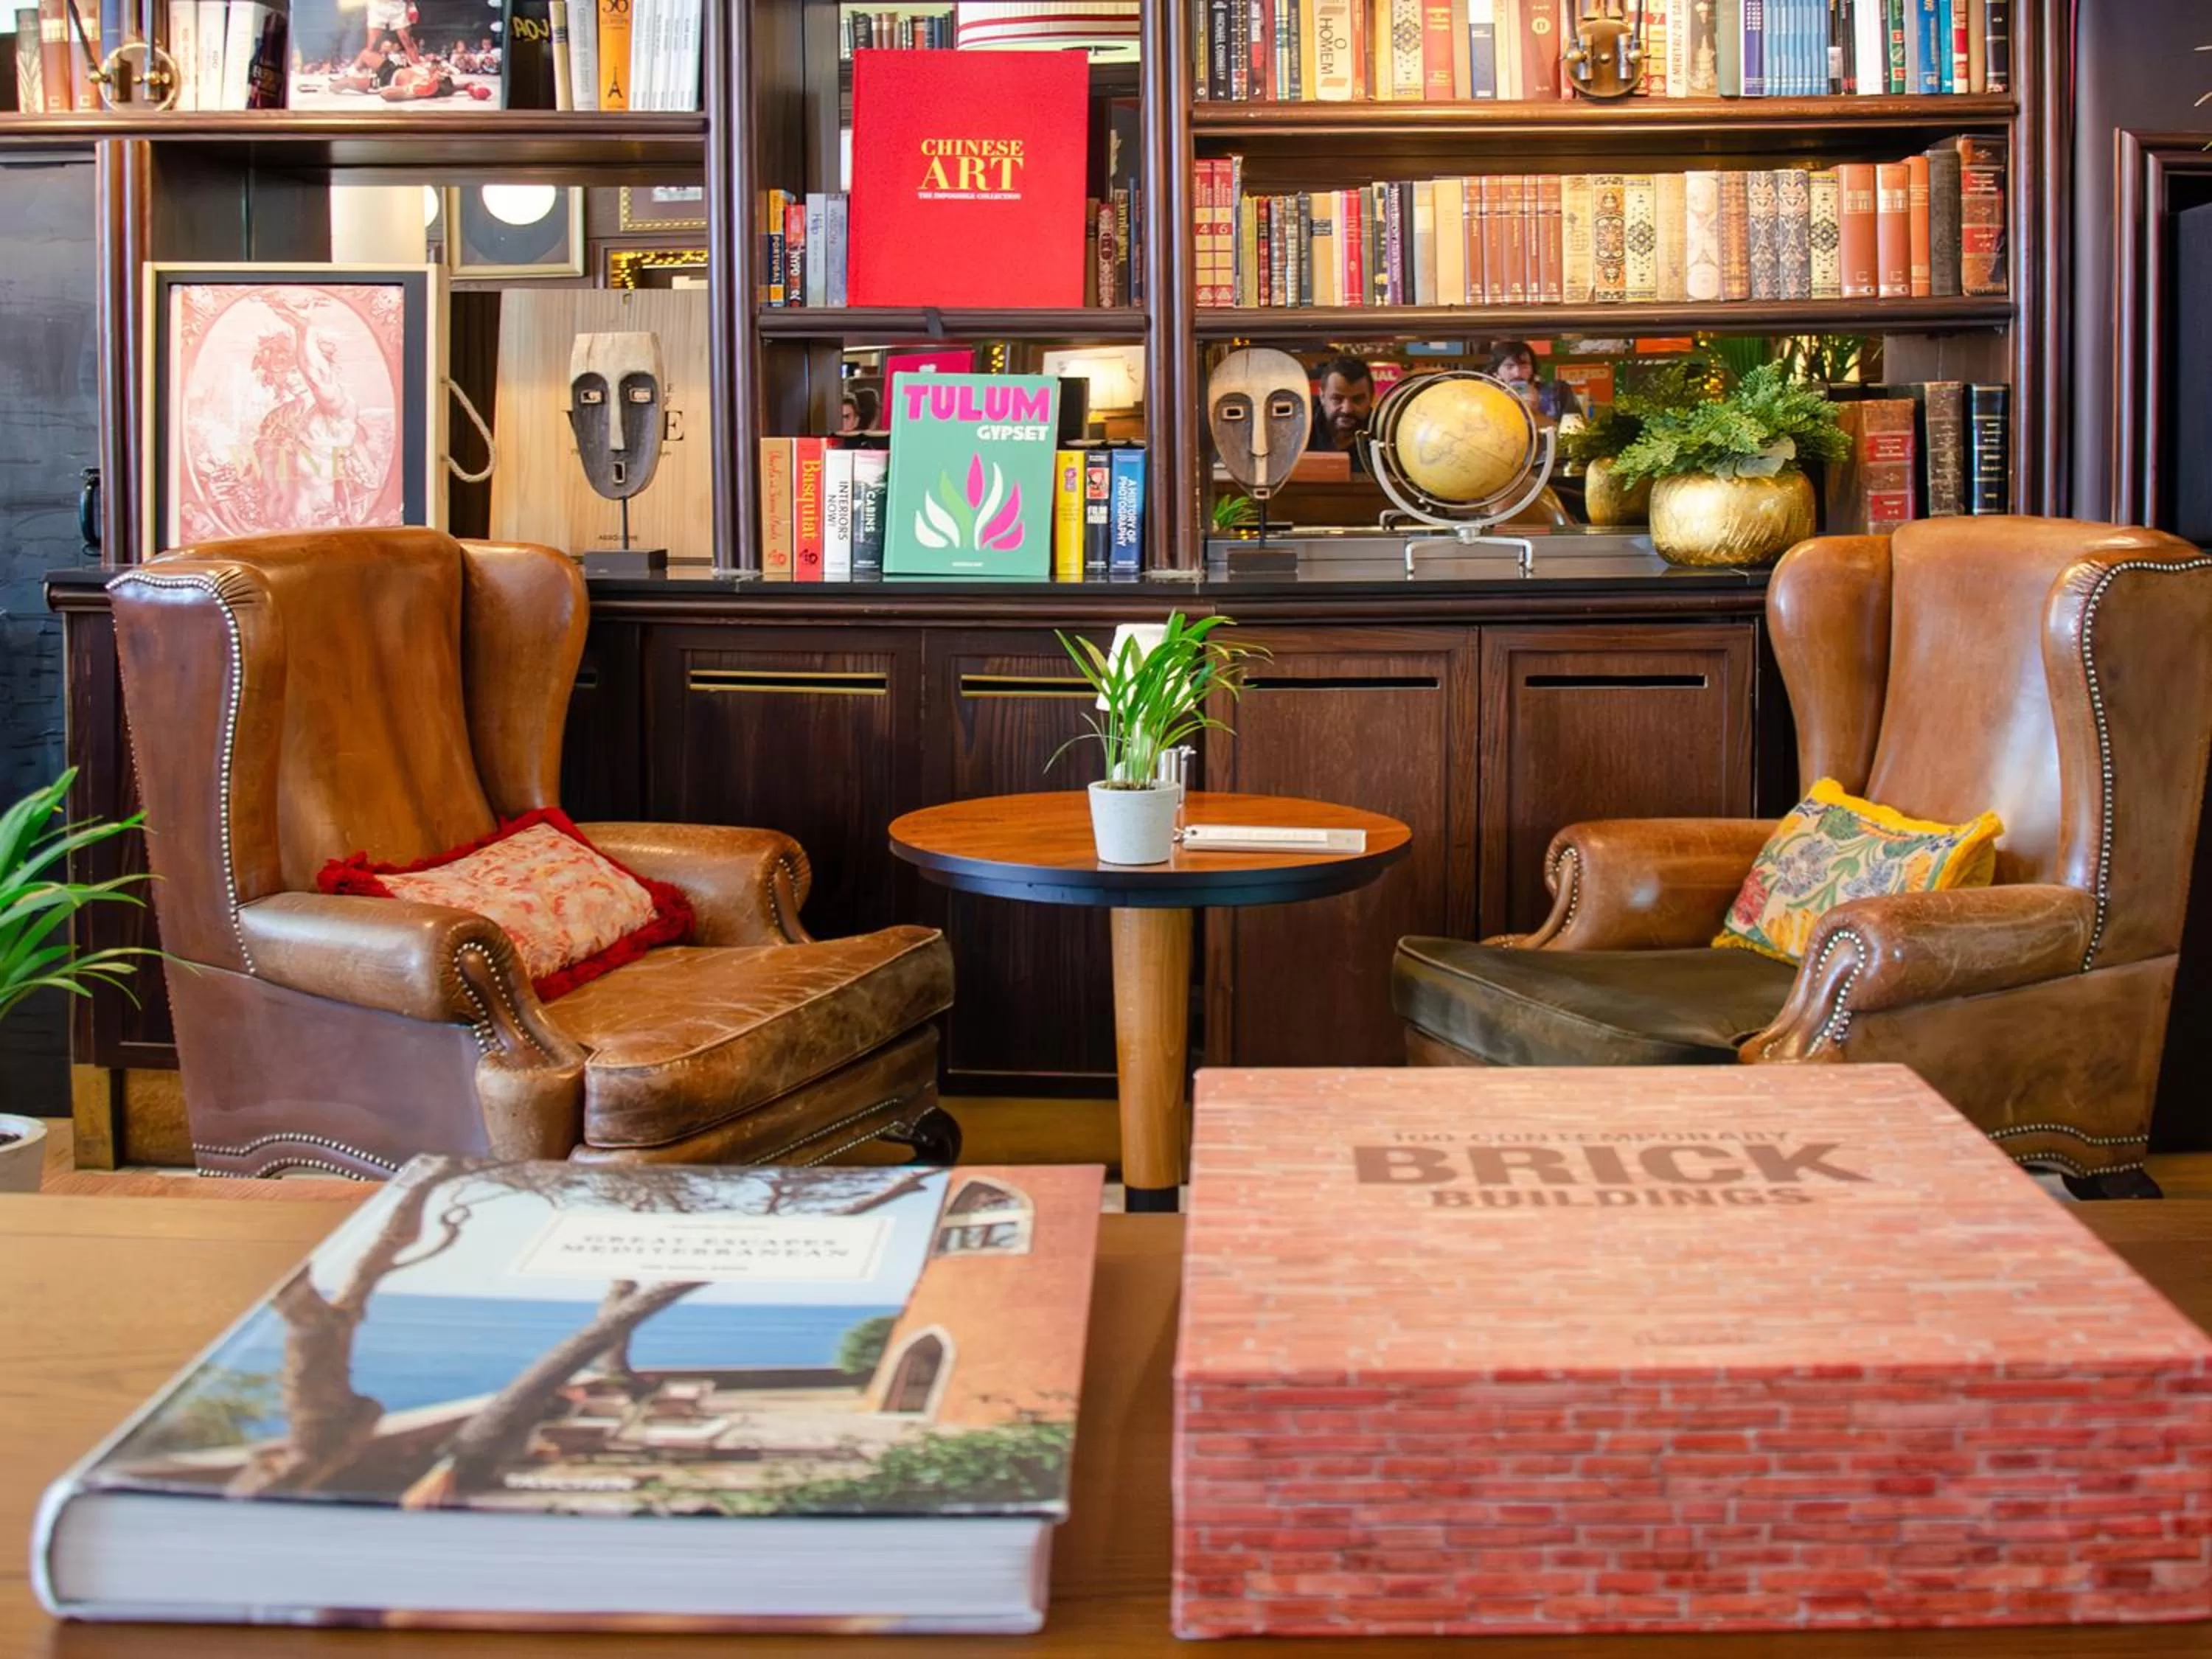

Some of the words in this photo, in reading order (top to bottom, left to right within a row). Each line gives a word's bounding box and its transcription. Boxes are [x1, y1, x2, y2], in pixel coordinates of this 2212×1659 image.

[1319, 17, 1333, 74] HOMEM
[921, 138, 1024, 156] CHINESE
[917, 156, 1024, 191] ART
[1199, 225, 1210, 234] 4
[1218, 224, 1228, 234] 6
[772, 235, 781, 282] PORTUGAL
[902, 383, 1051, 423] TULUM
[976, 425, 1049, 441] GYPSET
[796, 459, 821, 539] Basquiat
[827, 495, 837, 527] NOW!
[838, 481, 849, 541] INTERIORS
[865, 490, 876, 532] CABINS
[1116, 476, 1127, 546] PHOTOGRAPHY
[1127, 487, 1138, 528] HISTORY
[1470, 1131, 1789, 1142] CONTEMPORARY
[1353, 1144, 1875, 1183] BRICK
[1430, 1188, 1815, 1208] BUILDINGS
